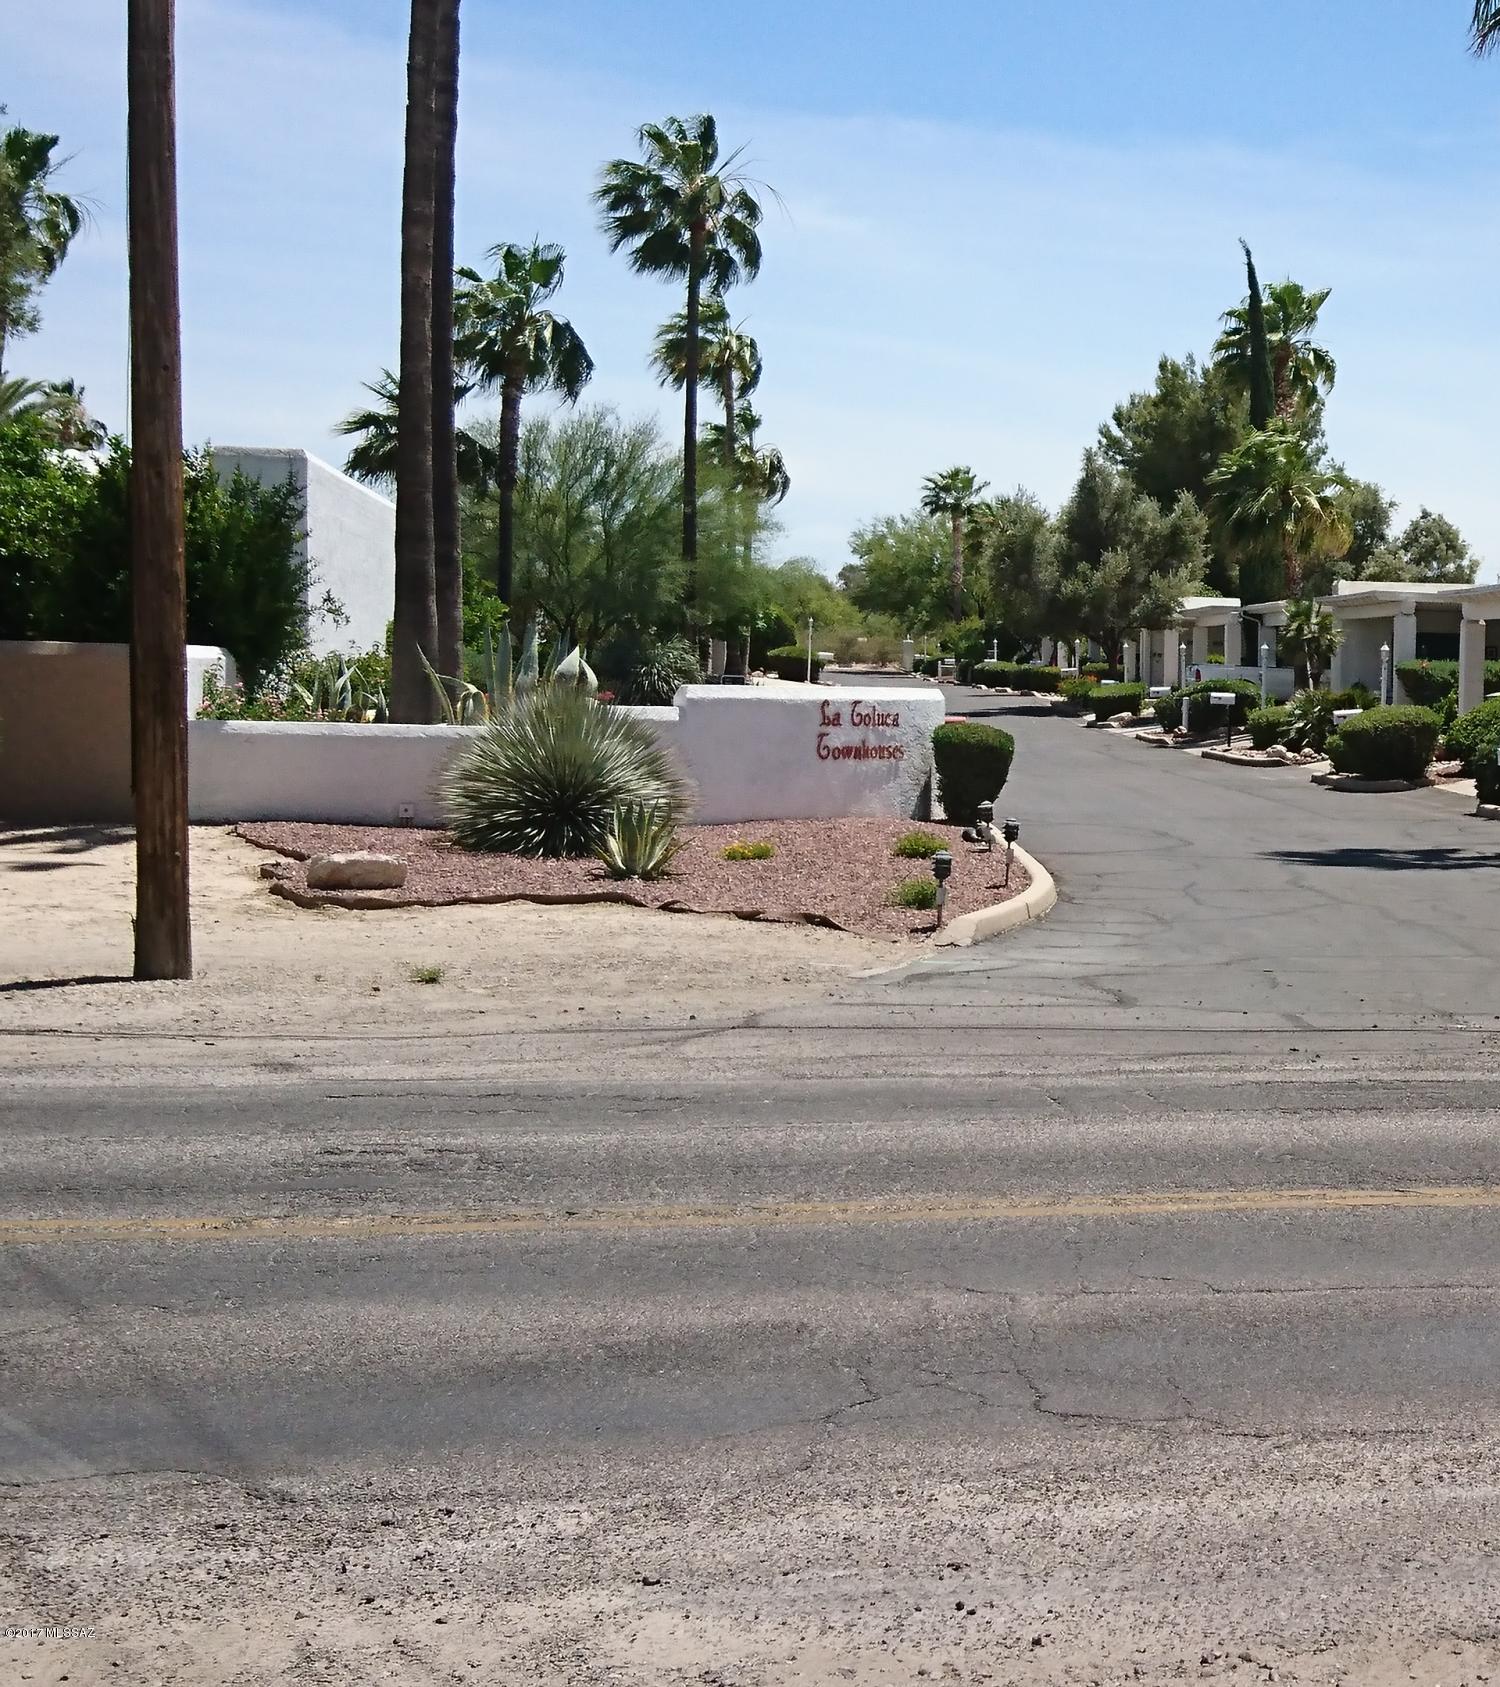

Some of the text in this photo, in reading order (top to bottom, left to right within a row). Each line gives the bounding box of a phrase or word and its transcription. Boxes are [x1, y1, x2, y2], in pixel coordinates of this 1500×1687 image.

[819, 699, 900, 727] La Toluca
[816, 732, 904, 760] Townhouses
